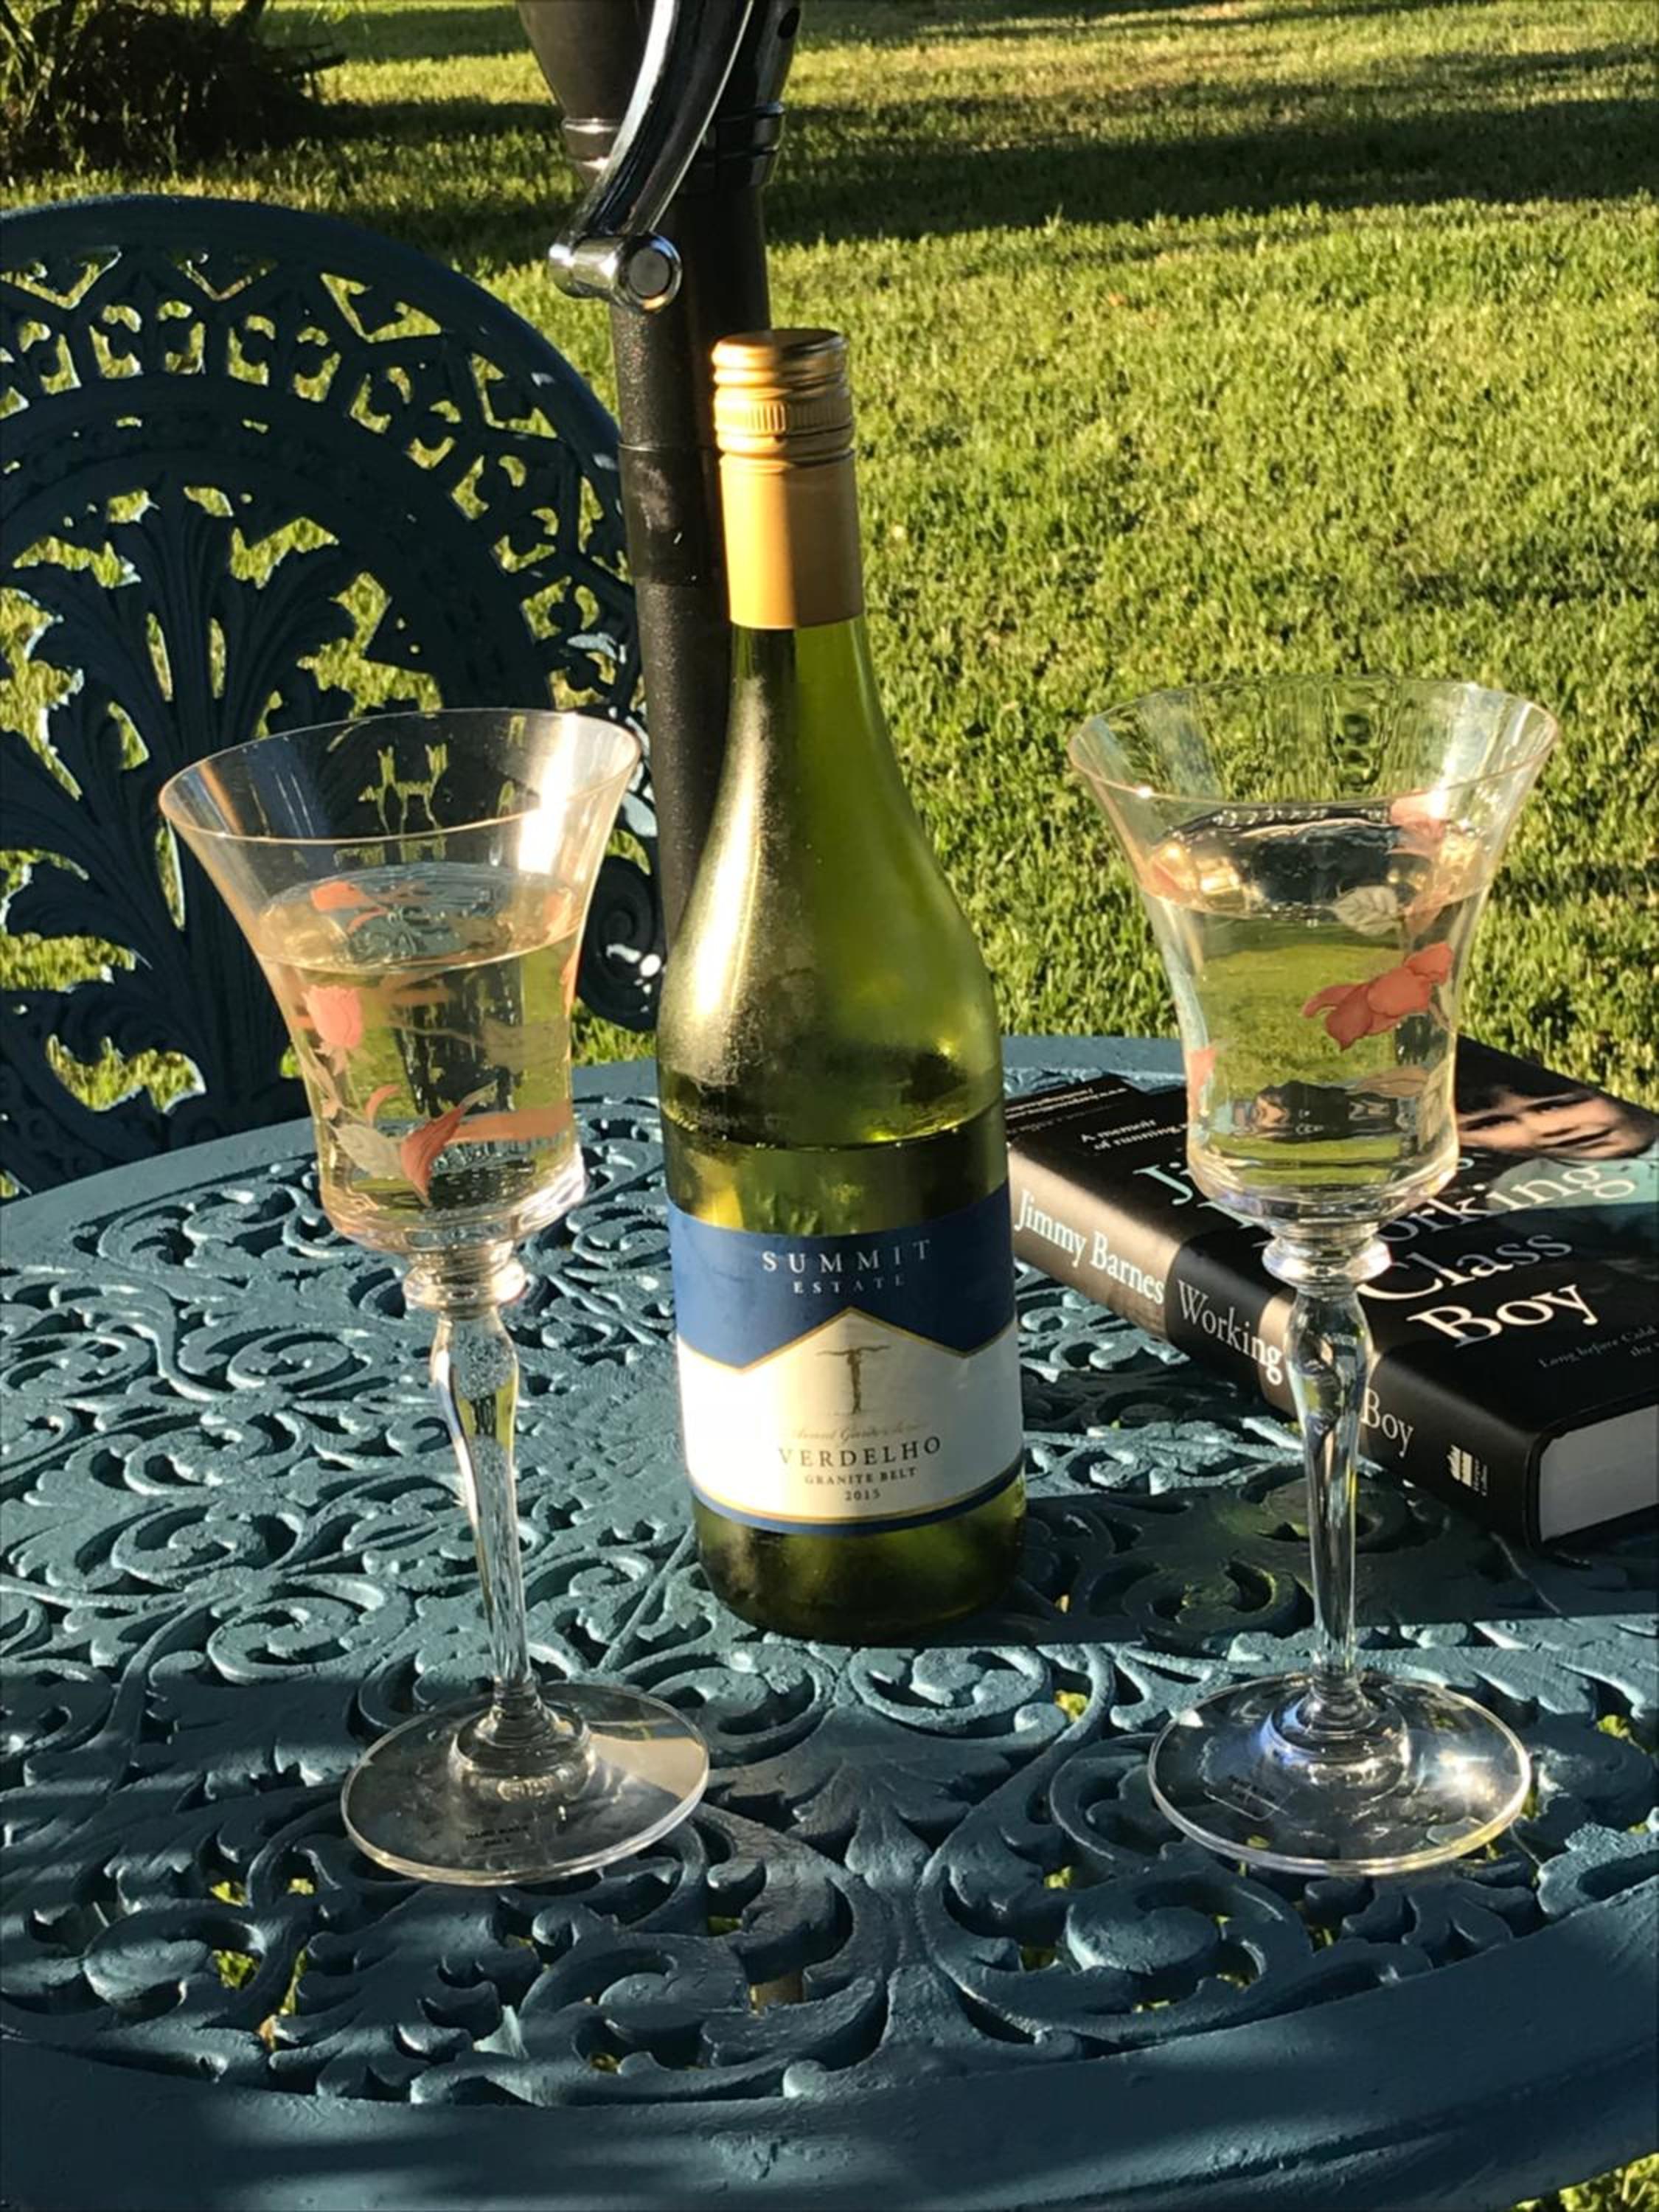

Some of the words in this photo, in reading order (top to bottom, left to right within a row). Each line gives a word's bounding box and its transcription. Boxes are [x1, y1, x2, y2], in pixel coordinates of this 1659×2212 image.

[1377, 1164, 1636, 1243] orking
[762, 1239, 931, 1274] SUMMIT
[1015, 1190, 1088, 1269] Jimmy
[1089, 1230, 1166, 1306] Barnes
[1356, 1234, 1573, 1301] Class
[793, 1276, 905, 1294] ESTATE
[1405, 1283, 1599, 1349] Boy
[1178, 1279, 1284, 1387] Working
[778, 1436, 942, 1468] VERDELHO
[1360, 1387, 1414, 1458] Boy
[804, 1473, 874, 1486] GRANITE
[879, 1467, 917, 1483] BELT
[844, 1491, 882, 1503] 2015
